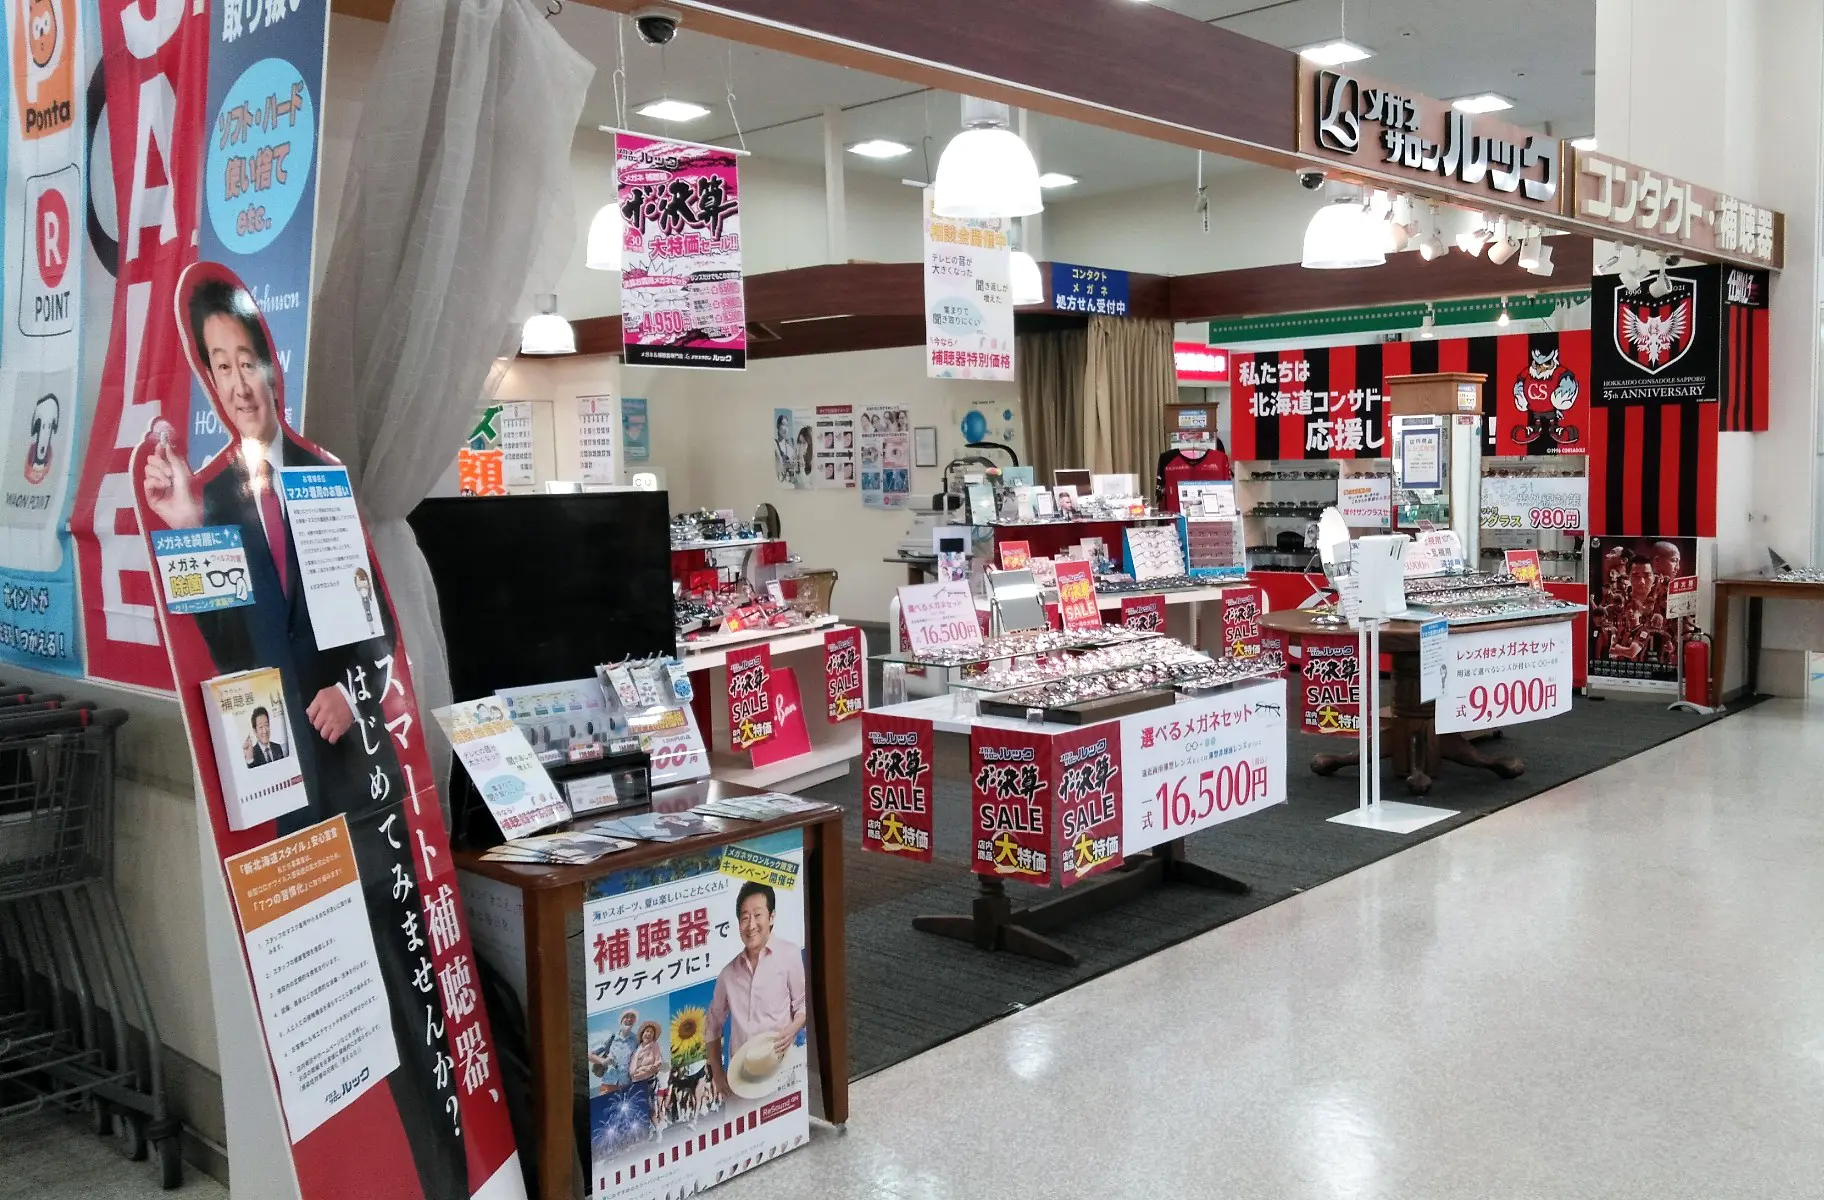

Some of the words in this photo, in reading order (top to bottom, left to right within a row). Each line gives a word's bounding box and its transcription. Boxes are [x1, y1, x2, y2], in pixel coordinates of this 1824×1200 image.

[26, 100, 71, 132] Ponta
[219, 80, 304, 150] ソフト・ハード
[1362, 88, 1421, 132] メガネ
[640, 152, 678, 168] ルック
[1382, 130, 1440, 172] サロン
[1441, 109, 1558, 201] ルック
[225, 142, 291, 199] 使い捨て
[236, 203, 272, 236] etc.
[931, 223, 1007, 250] 相談会開催中
[932, 253, 973, 266] テレビの音が
[932, 265, 973, 278] 大きくなった
[975, 279, 1009, 293] 聞き返しが
[1072, 268, 1107, 281] コンタクト
[983, 294, 1002, 304] 増えた
[1073, 283, 1108, 295] メガネ
[35, 291, 71, 322] POINT
[944, 306, 969, 316] 集まりで
[1056, 294, 1125, 316] 処方せん受付中
[932, 313, 980, 326] 聞き取りにくい
[931, 350, 1010, 369] 補聴器特別価格
[1239, 360, 1310, 386] 私たちは
[1603, 378, 1638, 387] HOKKAIDO
[1638, 377, 1676, 386] CONSADOLE
[1527, 383, 1548, 401] CS
[1603, 389, 1618, 401] 25th
[1621, 386, 1705, 399] ANNIVERSARY
[1529, 507, 1580, 530] 980円
[168, 557, 199, 572] メガネ
[169, 573, 204, 598] 除菌
[908, 602, 962, 613] 選べるメガネセット
[1065, 600, 1097, 620] SALE
[1226, 623, 1258, 641] SALE
[1233, 640, 1260, 657] 大特価
[1457, 638, 1556, 661] レンズ付きメガネセット
[829, 671, 860, 697] SALE
[1306, 685, 1360, 705] SALE
[220, 692, 255, 711] 補聴器
[732, 692, 769, 723] SALE
[836, 695, 862, 715] 大特価
[1469, 678, 1557, 722] 9,900円
[741, 718, 772, 741] 大特価
[886, 732, 918, 745] ルック
[1140, 704, 1252, 750] 選べるメガネセット
[1000, 747, 1035, 760] ルック
[1077, 738, 1107, 762] ルック
[869, 785, 926, 813] SALE
[1156, 760, 1267, 831] 16,500円
[980, 803, 1044, 834] SALE
[1062, 793, 1116, 840] SALE
[882, 812, 930, 850] 大特価
[240, 827, 338, 875] 「新北海道スタイル」安心宣言
[994, 832, 1047, 873] 大特価
[1075, 832, 1119, 868] 大特価
[375, 653, 499, 1102] スマート補聴器、
[722, 863, 796, 887] キャンペーン開催中
[346, 666, 462, 1136] はじめてみませんか?
[592, 879, 729, 921] 海やスポーツ、夏は楽しいことたくさん!
[593, 907, 730, 975] 補聴器で
[594, 953, 710, 1001] アクティブに!
[341, 1066, 370, 1096] ルック
[763, 1101, 790, 1118] ReSound
